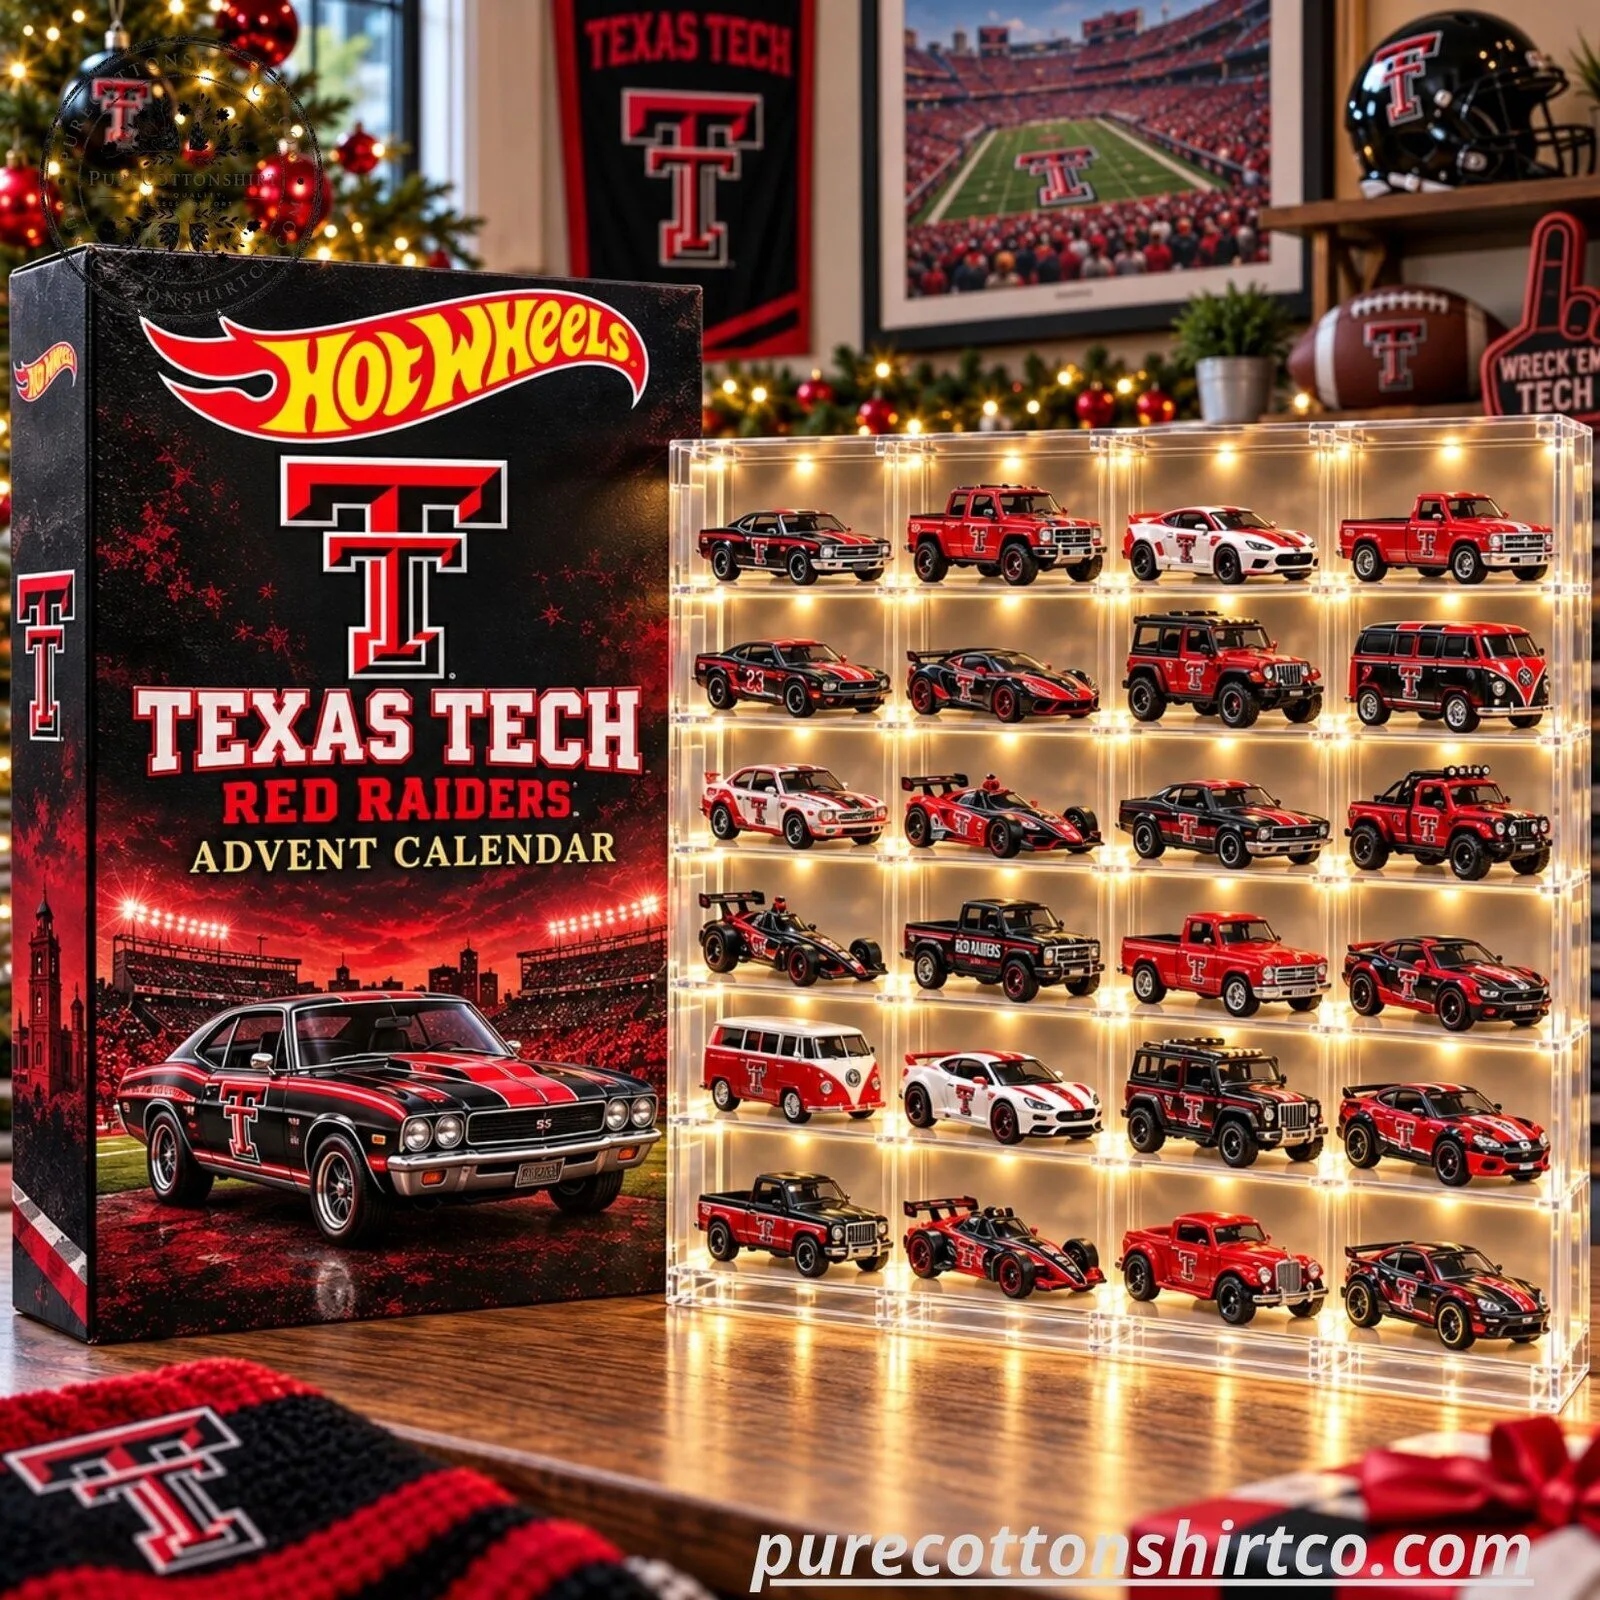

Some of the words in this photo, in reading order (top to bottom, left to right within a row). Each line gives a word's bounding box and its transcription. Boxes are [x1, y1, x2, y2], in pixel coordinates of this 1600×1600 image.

[584, 11, 698, 71] TEXAS
[704, 12, 792, 77] TECH
[253, 330, 423, 434] HOT
[1500, 348, 1570, 382] WRECK
[1515, 376, 1593, 414] TECH
[745, 669, 765, 694] 23
[134, 686, 413, 775] TEXAS
[431, 686, 643, 774] TECH
[223, 777, 338, 824] RED
[358, 777, 571, 821] RAIDERS
[190, 837, 377, 873] ADVENT
[394, 832, 616, 868] CALENDAR
